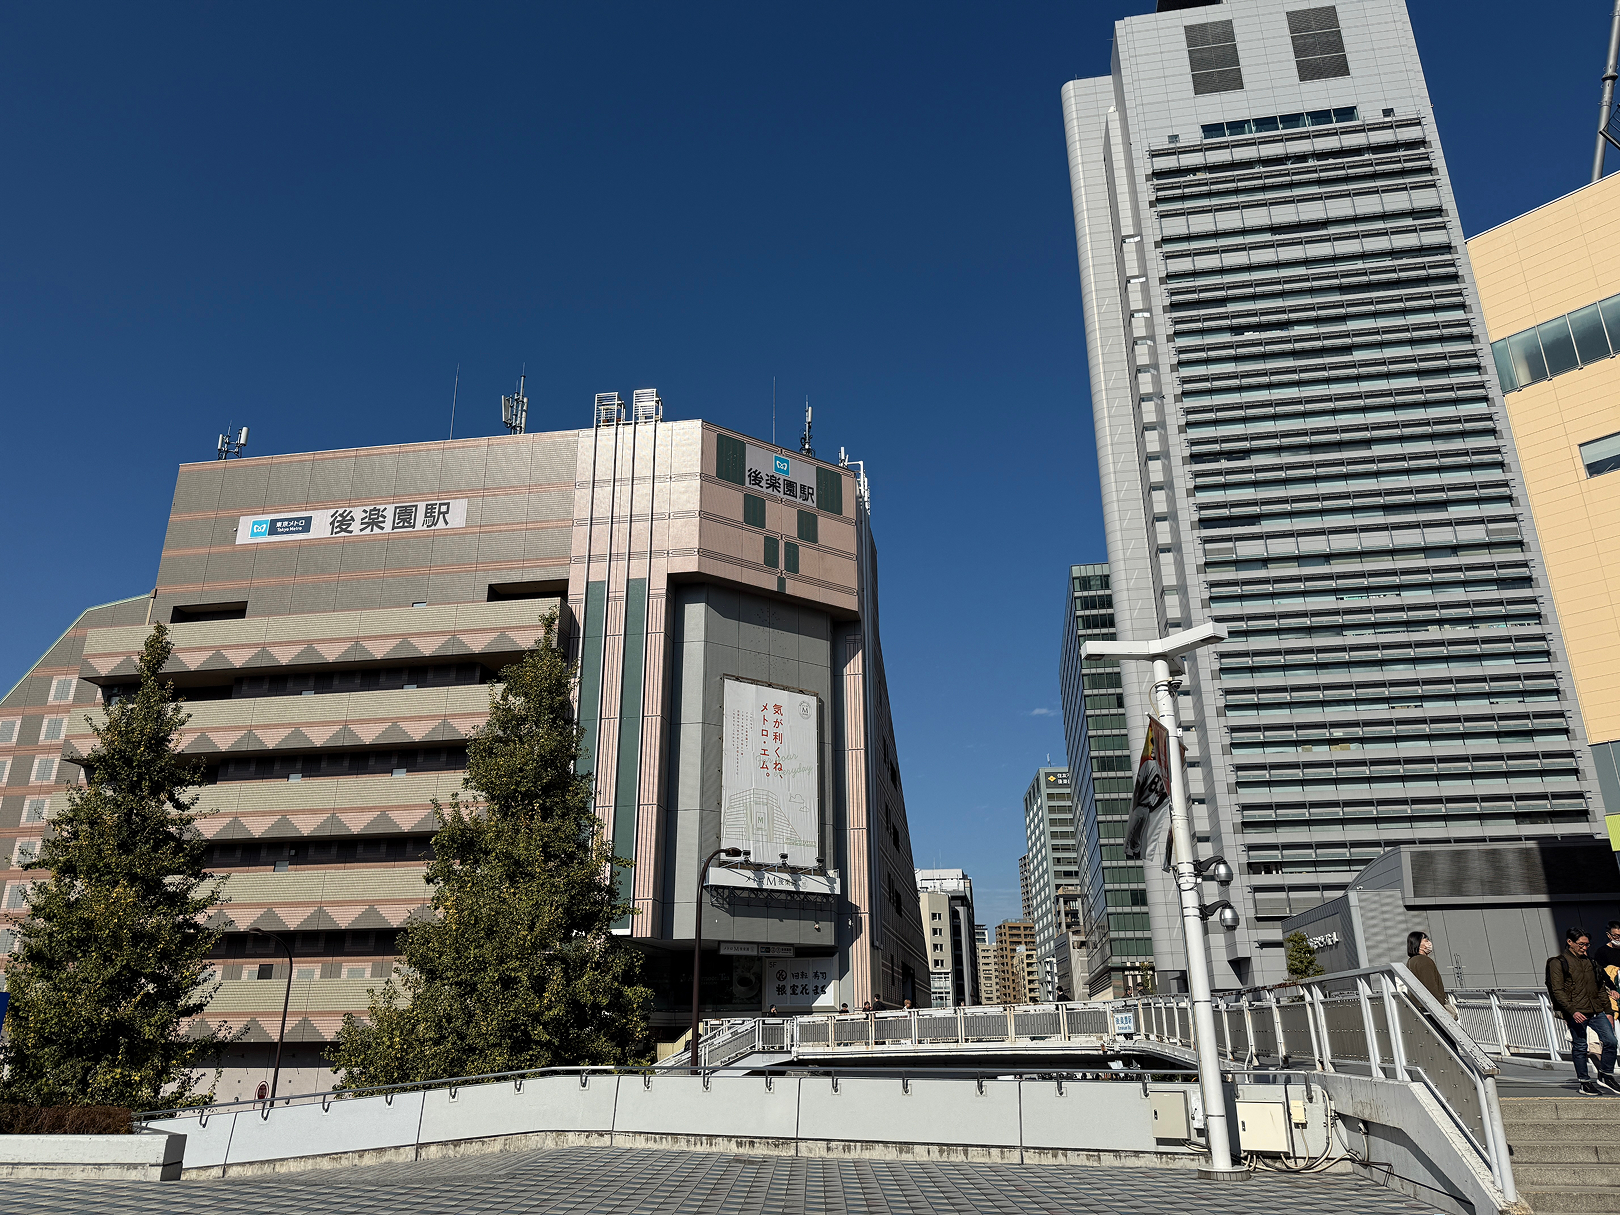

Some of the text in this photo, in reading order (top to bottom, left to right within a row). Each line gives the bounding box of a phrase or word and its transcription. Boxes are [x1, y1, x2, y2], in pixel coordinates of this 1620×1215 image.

[747, 467, 815, 504] 後楽園駅
[275, 519, 306, 528] 東京メトロ
[329, 501, 451, 536] 後楽園駅
[760, 702, 770, 778] メトロ・エム。
[772, 703, 784, 779] 気が利くね、
[769, 961, 777, 969] 5F
